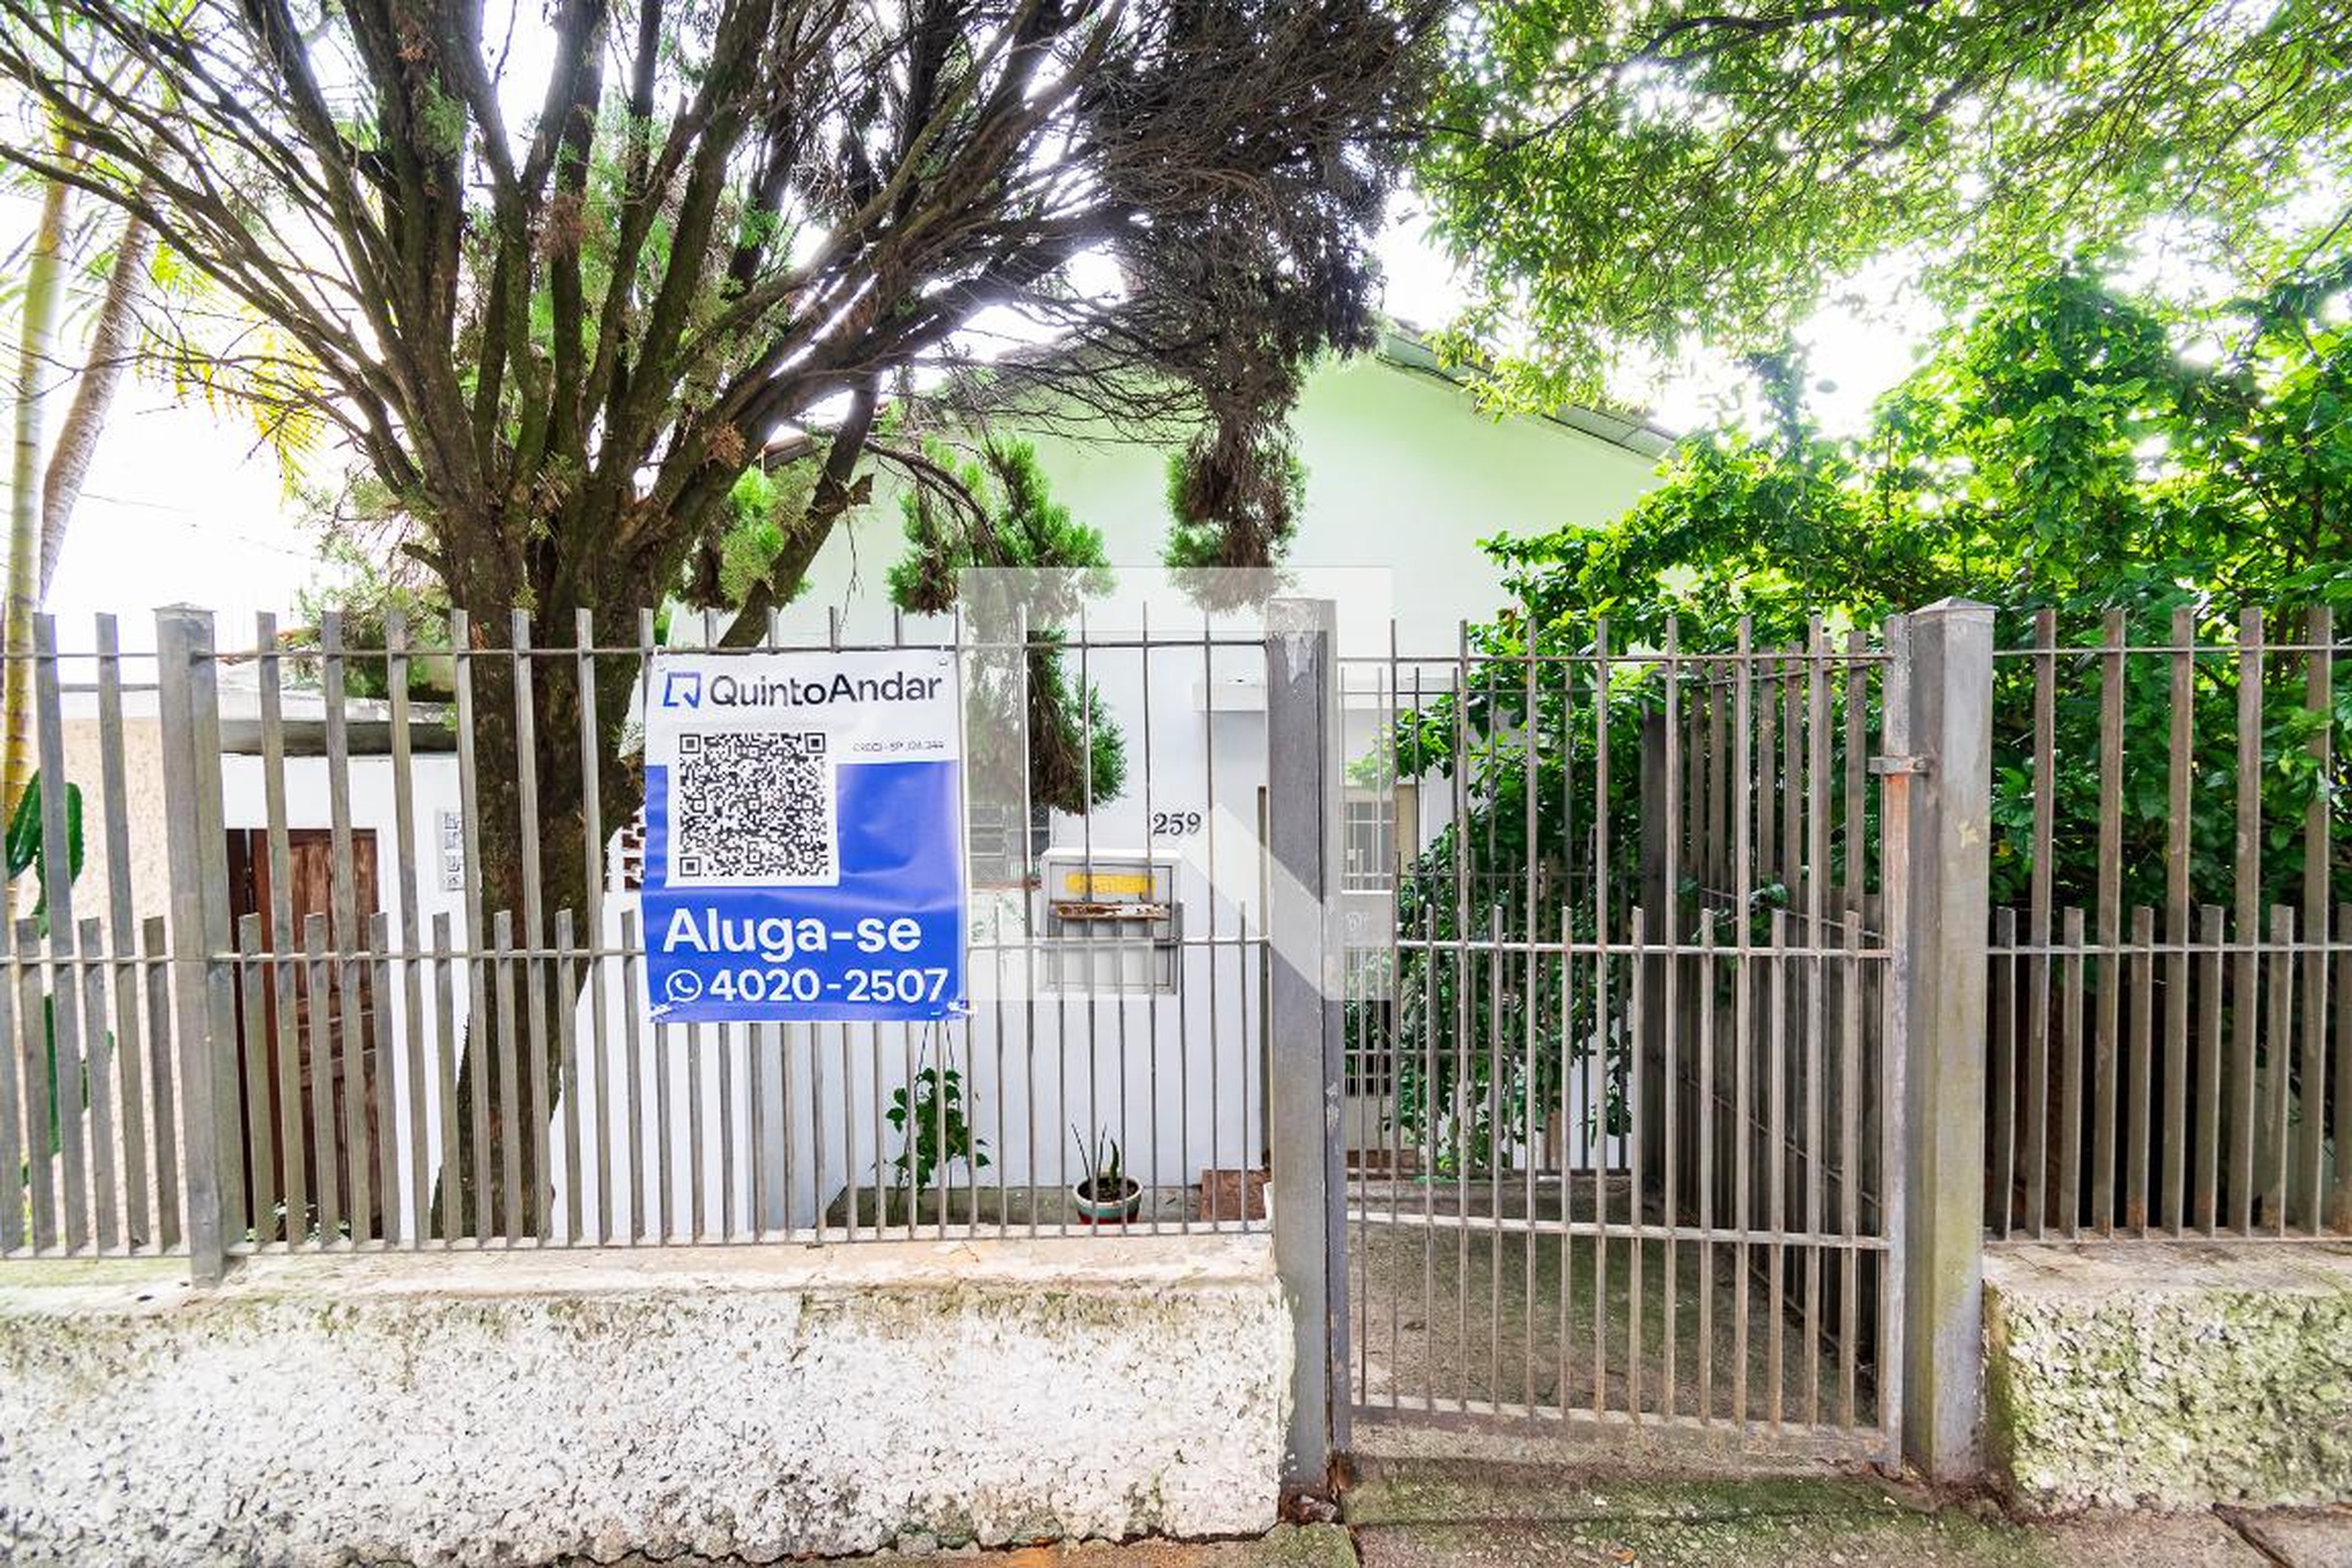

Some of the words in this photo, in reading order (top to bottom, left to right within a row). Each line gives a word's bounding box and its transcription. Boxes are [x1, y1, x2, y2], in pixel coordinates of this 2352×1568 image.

[709, 671, 942, 707] QuintoAndar
[1153, 812, 1201, 836] 259
[662, 908, 921, 963] Aluga-se
[709, 968, 949, 1003] 4020-2507
